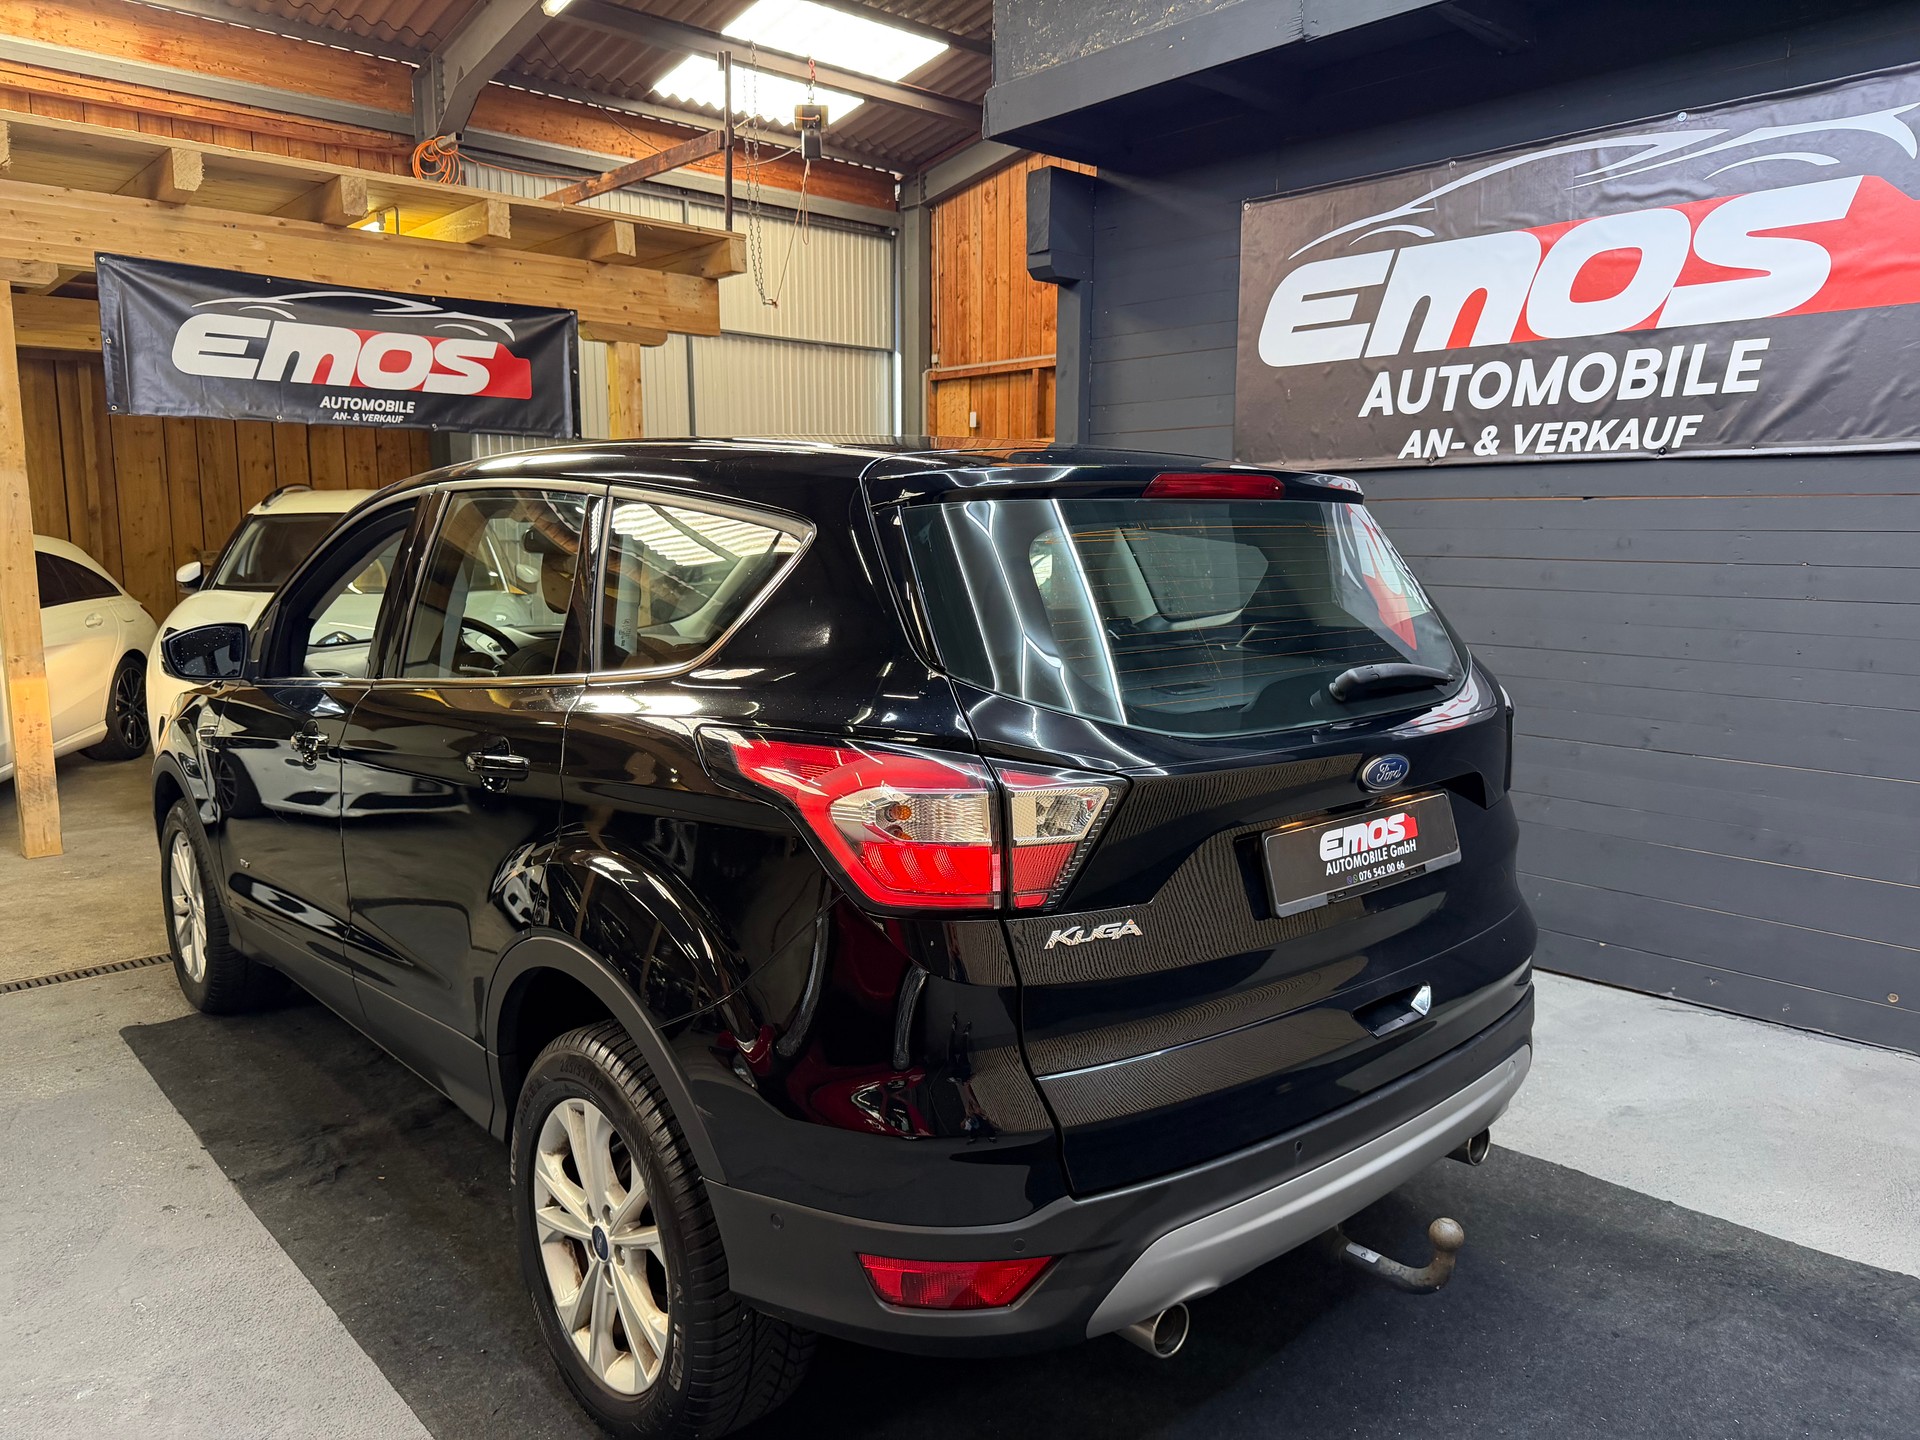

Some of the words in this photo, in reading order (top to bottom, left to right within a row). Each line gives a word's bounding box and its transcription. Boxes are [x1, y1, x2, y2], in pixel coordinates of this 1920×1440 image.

[1357, 337, 1771, 418] AUTOMOBILE
[319, 395, 416, 414] AUTOMOBILE
[332, 411, 352, 422] AN-
[352, 412, 360, 422] &
[361, 413, 405, 424] VERKAUF
[1398, 426, 1466, 460] AN-
[1473, 424, 1500, 457] &
[1513, 414, 1703, 455] VERKAUF
[1376, 761, 1402, 783] Ford
[1325, 847, 1388, 876] AUTOMOBILE
[1390, 839, 1417, 858] GmbH
[1358, 869, 1372, 882] 076
[1373, 865, 1386, 877] 542
[1386, 862, 1396, 873] 00
[1396, 859, 1406, 870] 66
[1043, 918, 1144, 950] KUGA
